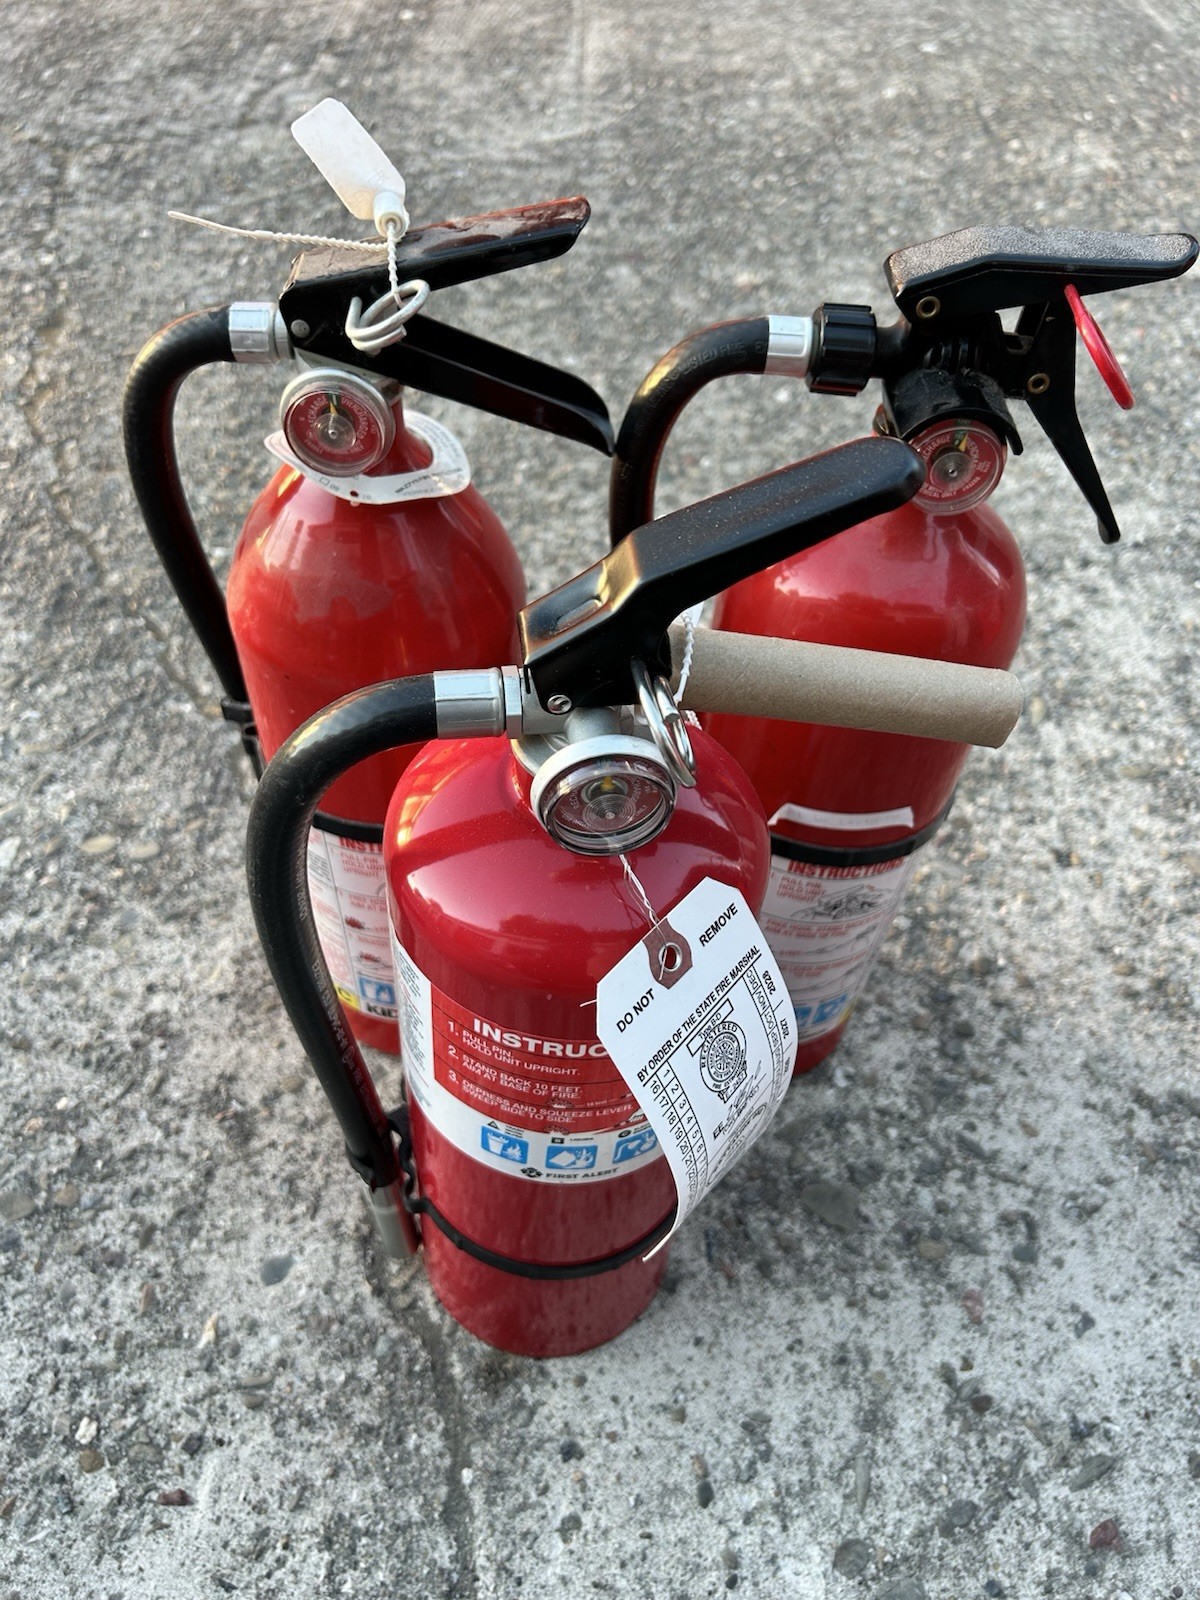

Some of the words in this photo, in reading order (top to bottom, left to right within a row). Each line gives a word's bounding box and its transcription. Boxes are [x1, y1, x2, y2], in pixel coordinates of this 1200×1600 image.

[698, 903, 738, 947] REMOVE
[746, 969, 758, 990] DEC
[756, 990, 768, 1011] NOV
[764, 1010, 774, 1030] OCT
[762, 970, 776, 995] 2028
[616, 1012, 633, 1033] DO
[633, 988, 656, 1014] NOT
[636, 1065, 652, 1082] BY
[649, 1042, 675, 1070] ORDER
[673, 1028, 684, 1044] OF
[682, 1013, 696, 1034] THE
[697, 991, 715, 1018] STATE
[714, 976, 732, 999] FIRE
[730, 945, 760, 982] MARSHAL
[448, 1021, 459, 1036] 1.
[462, 1030, 488, 1046] PULL
[492, 1046, 514, 1058] PIN.
[462, 1038, 492, 1056] HOLD
[494, 1052, 521, 1067] UNIT
[524, 1062, 580, 1076] UPRIGHT.
[472, 1018, 608, 1058] INSTRUC
[448, 1044, 459, 1060] 2.
[462, 1054, 498, 1076] STAND
[500, 1073, 532, 1086] BACK
[462, 1062, 482, 1076] AIM
[484, 1072, 497, 1082] AT
[500, 1079, 530, 1093] BASE
[532, 1088, 550, 1096] OF
[448, 1069, 459, 1084] 3.
[462, 1079, 510, 1106] DEPRESS
[512, 1102, 537, 1113] AND
[540, 1108, 593, 1118] SQUEEZE
[596, 1104, 634, 1116] LEVER.
[462, 1086, 498, 1106] SWEEP
[500, 1104, 525, 1117] SIDE
[664, 1069, 670, 1078] 1
[670, 1084, 679, 1094] 2
[679, 1100, 686, 1109] 3
[687, 1116, 693, 1125] 4
[692, 1130, 699, 1138] 5
[650, 1080, 660, 1094] 16
[660, 1096, 669, 1108] 17
[667, 1111, 676, 1125] 18
[674, 1126, 683, 1140] 19
[680, 1140, 689, 1155] 20
[581, 1168, 618, 1178] ALERT
